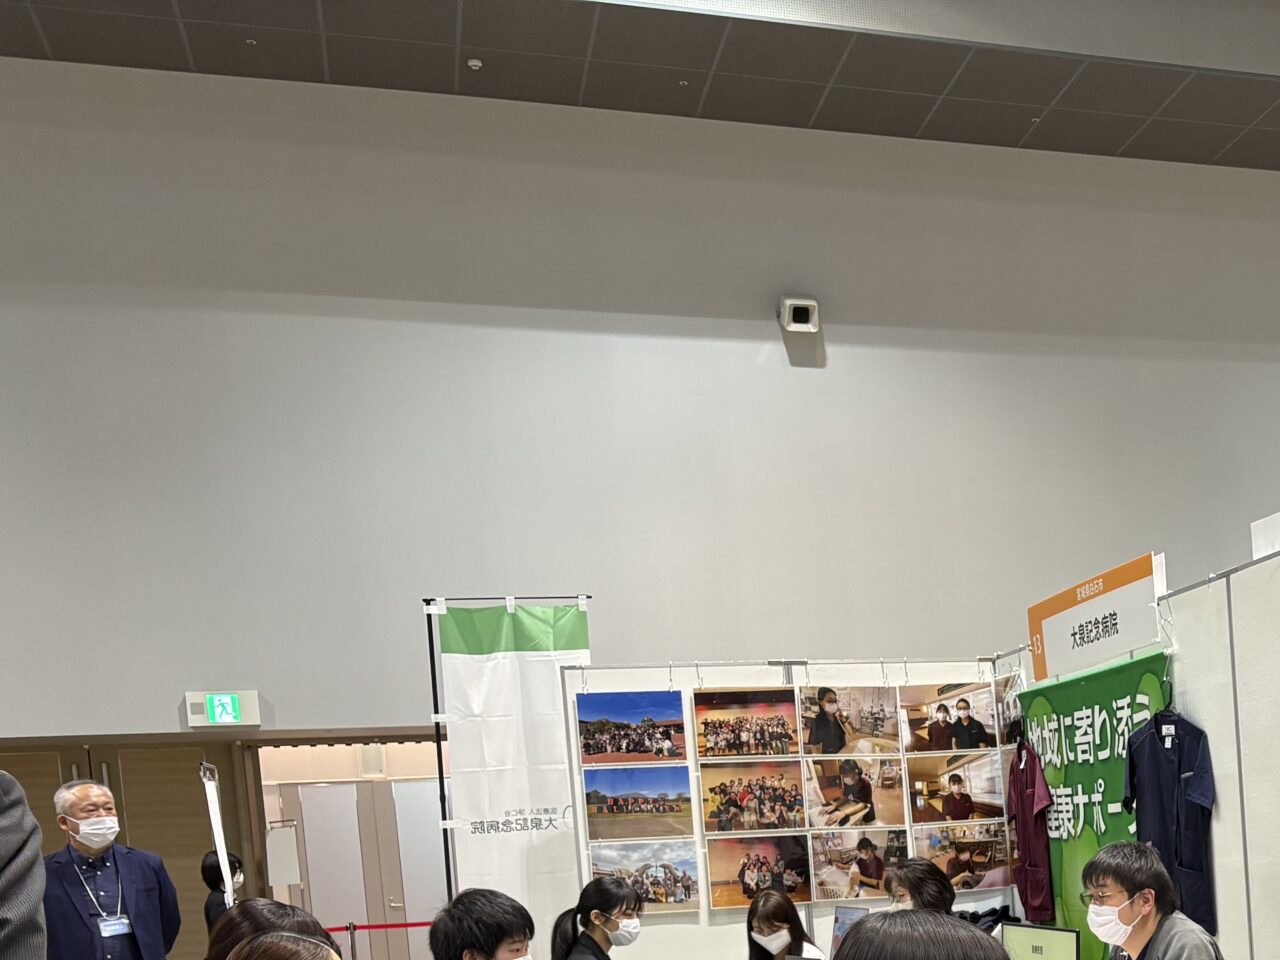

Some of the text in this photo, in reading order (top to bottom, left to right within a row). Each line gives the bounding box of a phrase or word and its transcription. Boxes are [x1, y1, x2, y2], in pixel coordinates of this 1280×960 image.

[1032, 634, 1042, 655] 13
[1071, 610, 1119, 650] 大泉記念病院
[1047, 779, 1137, 841] 健康サポー
